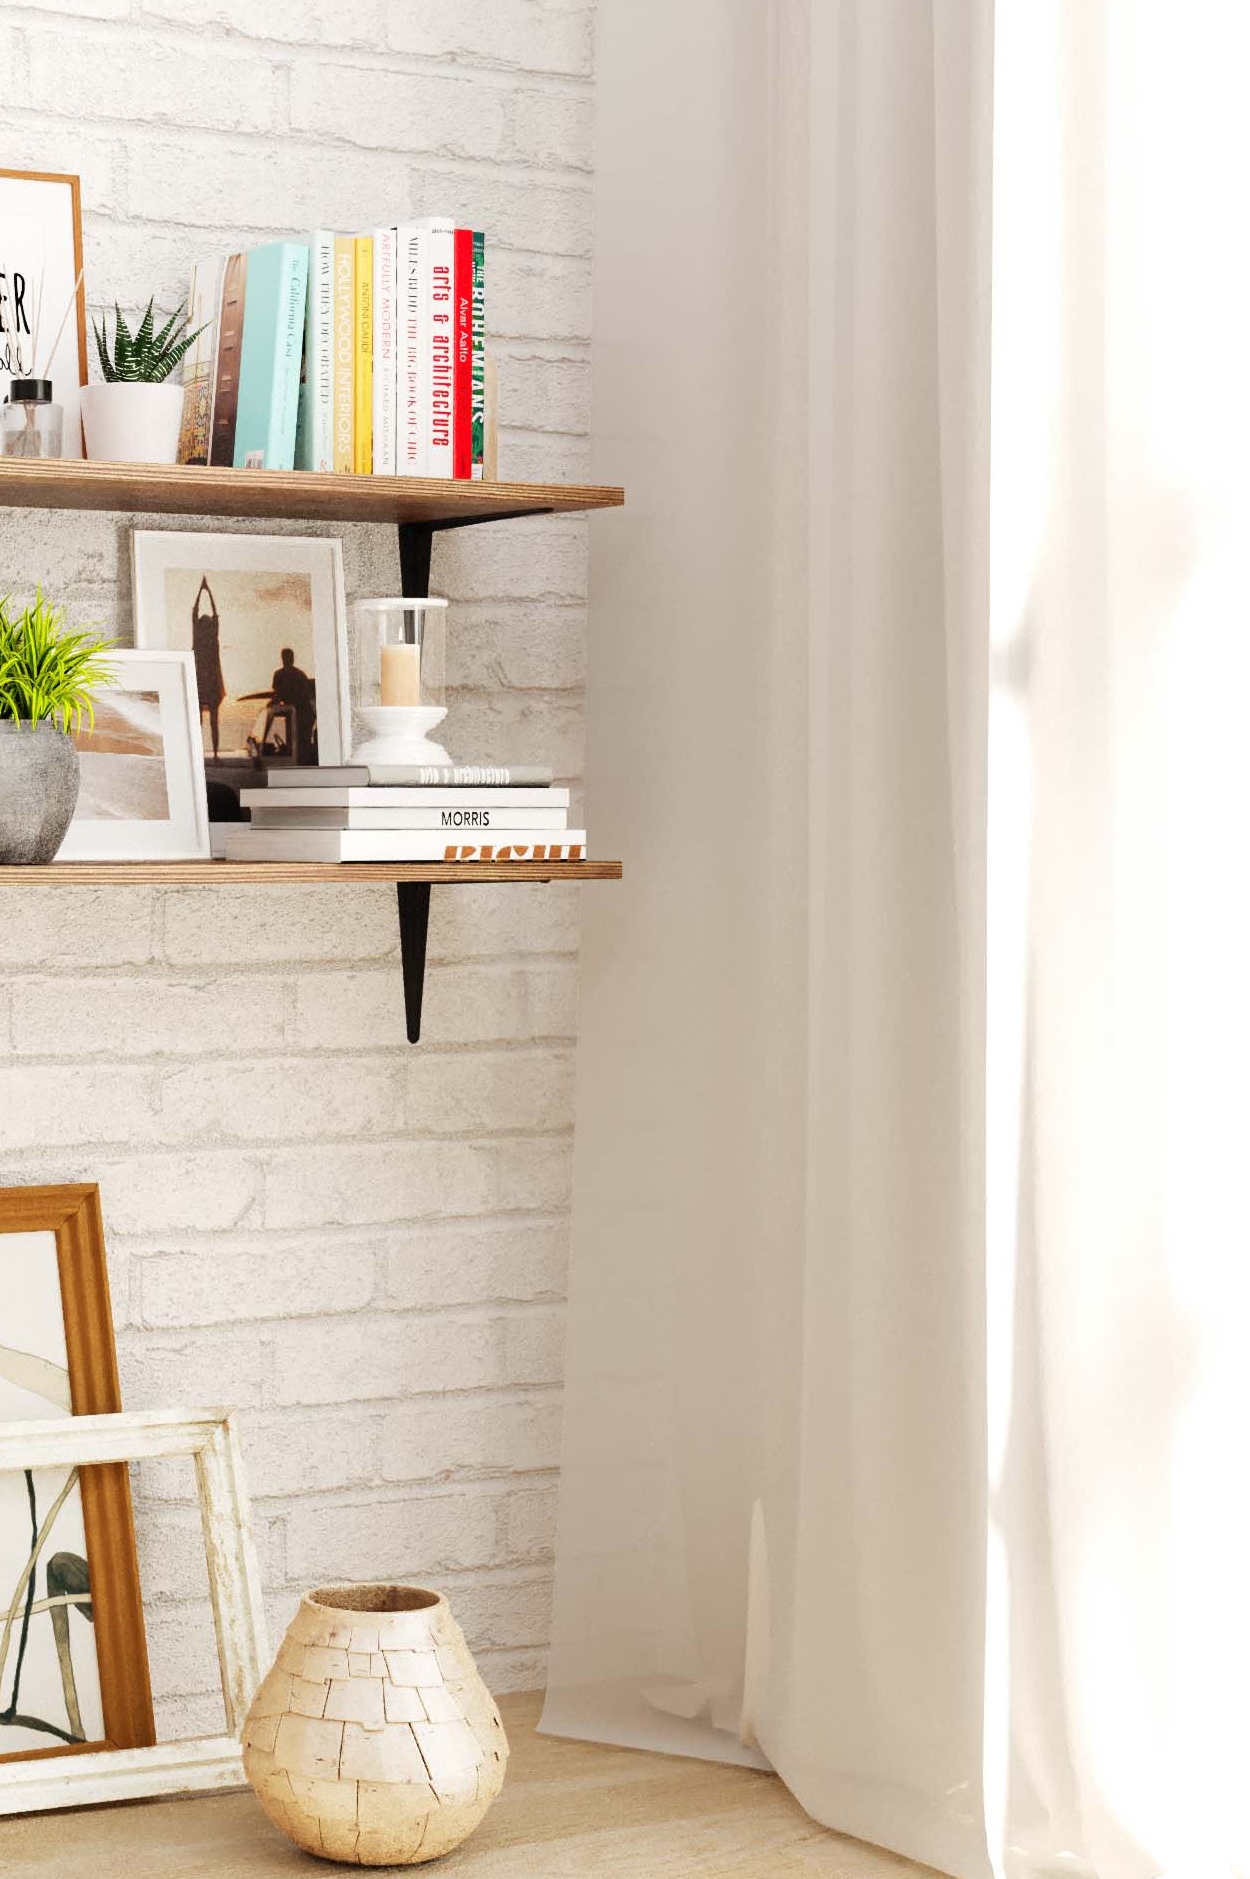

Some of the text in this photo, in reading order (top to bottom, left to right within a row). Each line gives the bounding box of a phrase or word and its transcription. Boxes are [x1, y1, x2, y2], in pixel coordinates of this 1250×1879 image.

[380, 233, 392, 294] ARTFULLY
[433, 265, 452, 302] arts
[337, 253, 352, 363] HOLLYWOOD
[381, 297, 392, 360] MODERN
[459, 297, 470, 364] Alvar Aalto
[337, 366, 353, 454] INTERIORS
[433, 335, 453, 448] architecture
[440, 811, 491, 826] MORRIS
